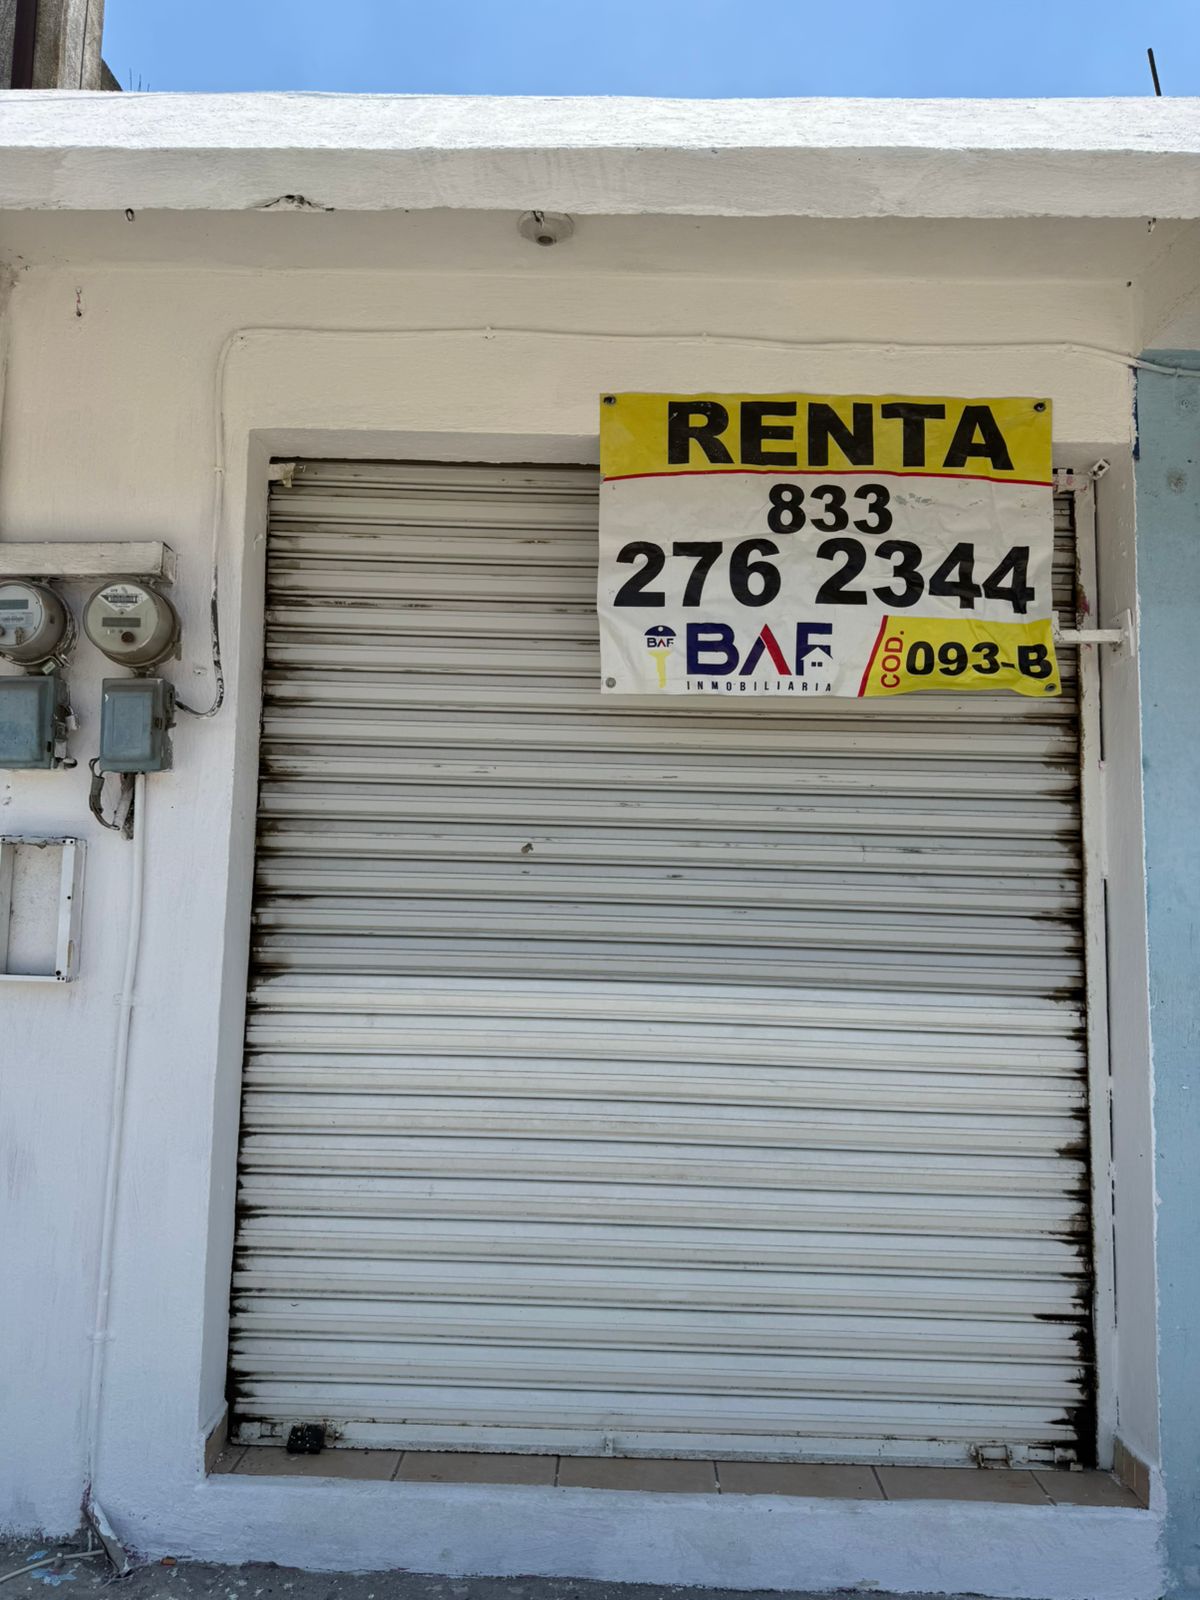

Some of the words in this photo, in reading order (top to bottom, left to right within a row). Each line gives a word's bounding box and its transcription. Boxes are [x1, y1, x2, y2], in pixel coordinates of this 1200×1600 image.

[668, 401, 1014, 470] RENTA
[767, 483, 893, 534] 833
[613, 538, 781, 607] 276
[815, 538, 1035, 614] 2344
[647, 638, 674, 648] BAF
[686, 622, 833, 676] BAF
[881, 630, 904, 688] COD.
[906, 641, 1053, 679] 093-B
[687, 681, 831, 692] INMOBILIARIA
